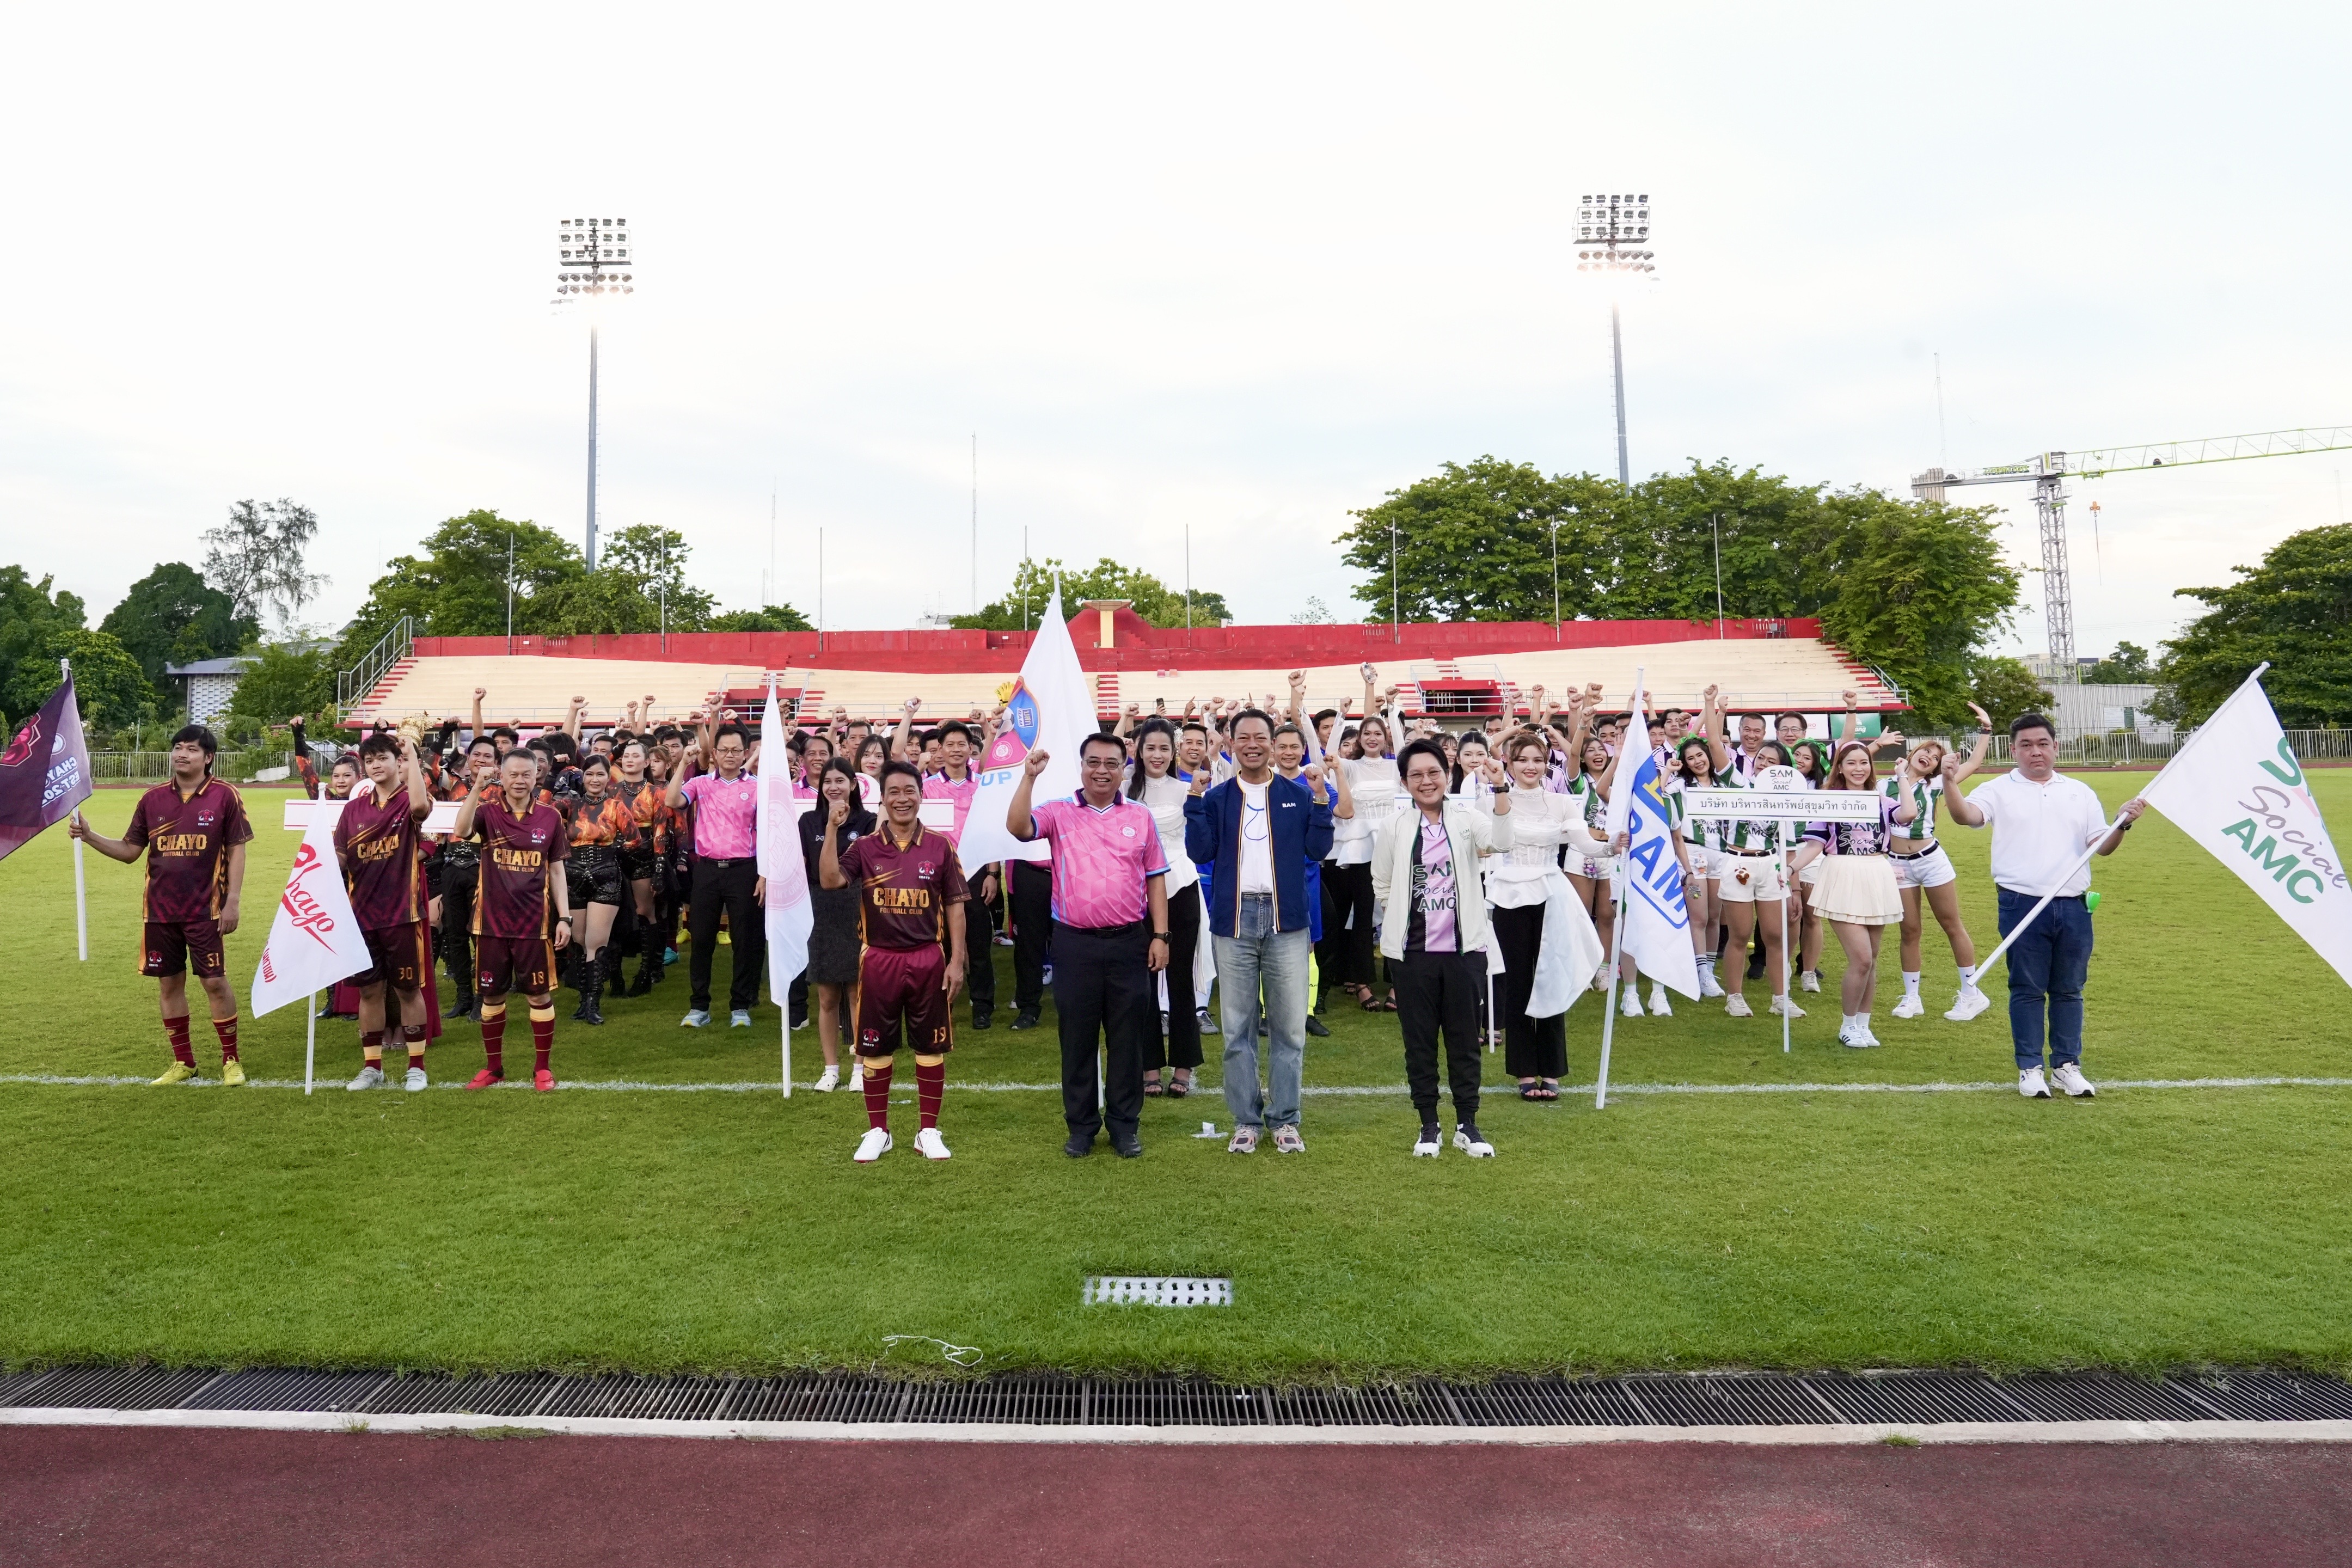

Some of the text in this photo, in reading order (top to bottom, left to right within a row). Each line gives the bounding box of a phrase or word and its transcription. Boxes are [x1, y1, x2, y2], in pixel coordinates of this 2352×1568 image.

[981, 771, 1012, 786] UP
[1769, 769, 1793, 777] SAM
[1589, 803, 1607, 816] SA
[1700, 797, 1867, 813] บริษัท บริหารสินทรัพย์สุขุมวิท จำกัด
[156, 834, 207, 852] CHAYO
[357, 834, 400, 859] CHAYO
[1838, 832, 1884, 847] Social
[493, 848, 542, 867] CHAYO
[2221, 818, 2324, 904] AMC
[873, 887, 930, 908] CHAYO
[1412, 882, 1456, 898] Socia
[1417, 897, 1456, 912] AMC
[398, 966, 413, 980] 30
[531, 971, 544, 985] 18
[933, 1026, 946, 1044] 19
